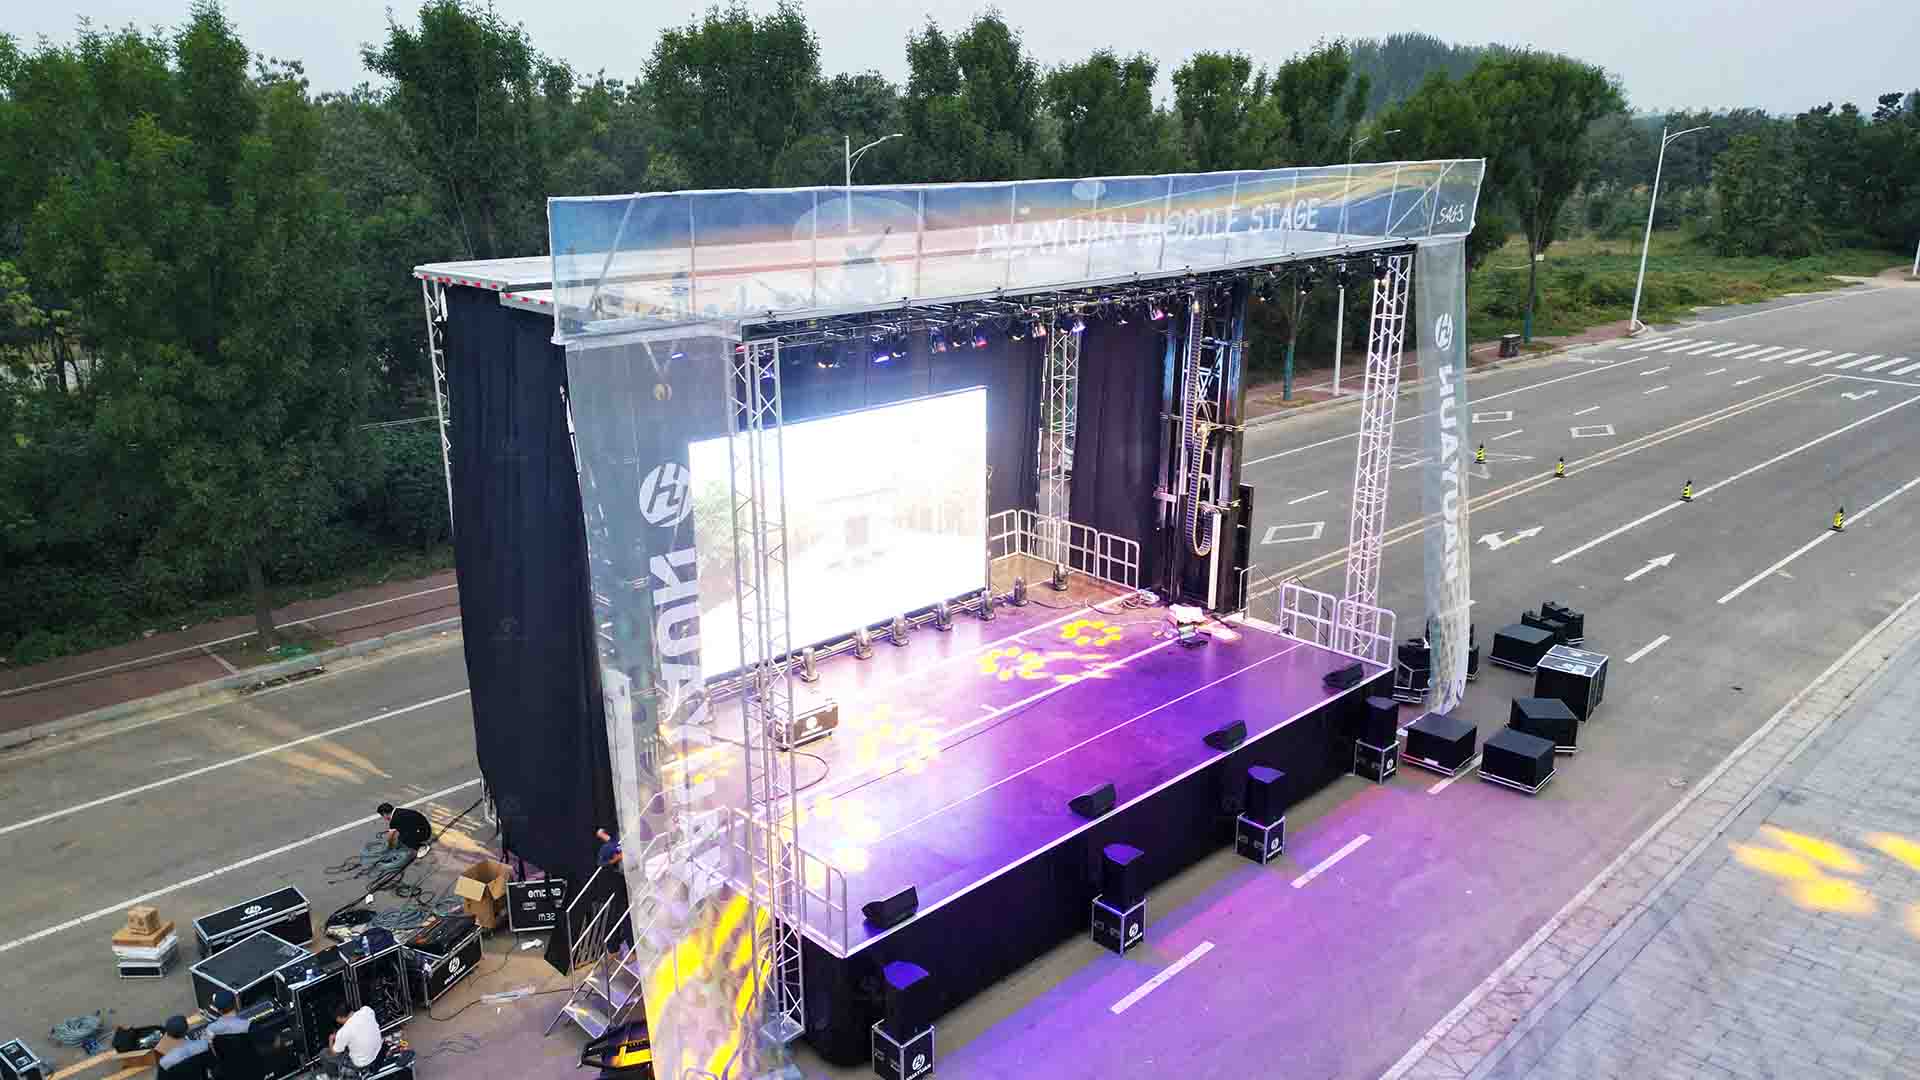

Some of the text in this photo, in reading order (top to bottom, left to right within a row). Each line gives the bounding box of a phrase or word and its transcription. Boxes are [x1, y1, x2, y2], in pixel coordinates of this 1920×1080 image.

[1142, 202, 1240, 243] MOBILE
[1248, 197, 1320, 233] STAGE
[1438, 363, 1459, 582] HUAYUAN
